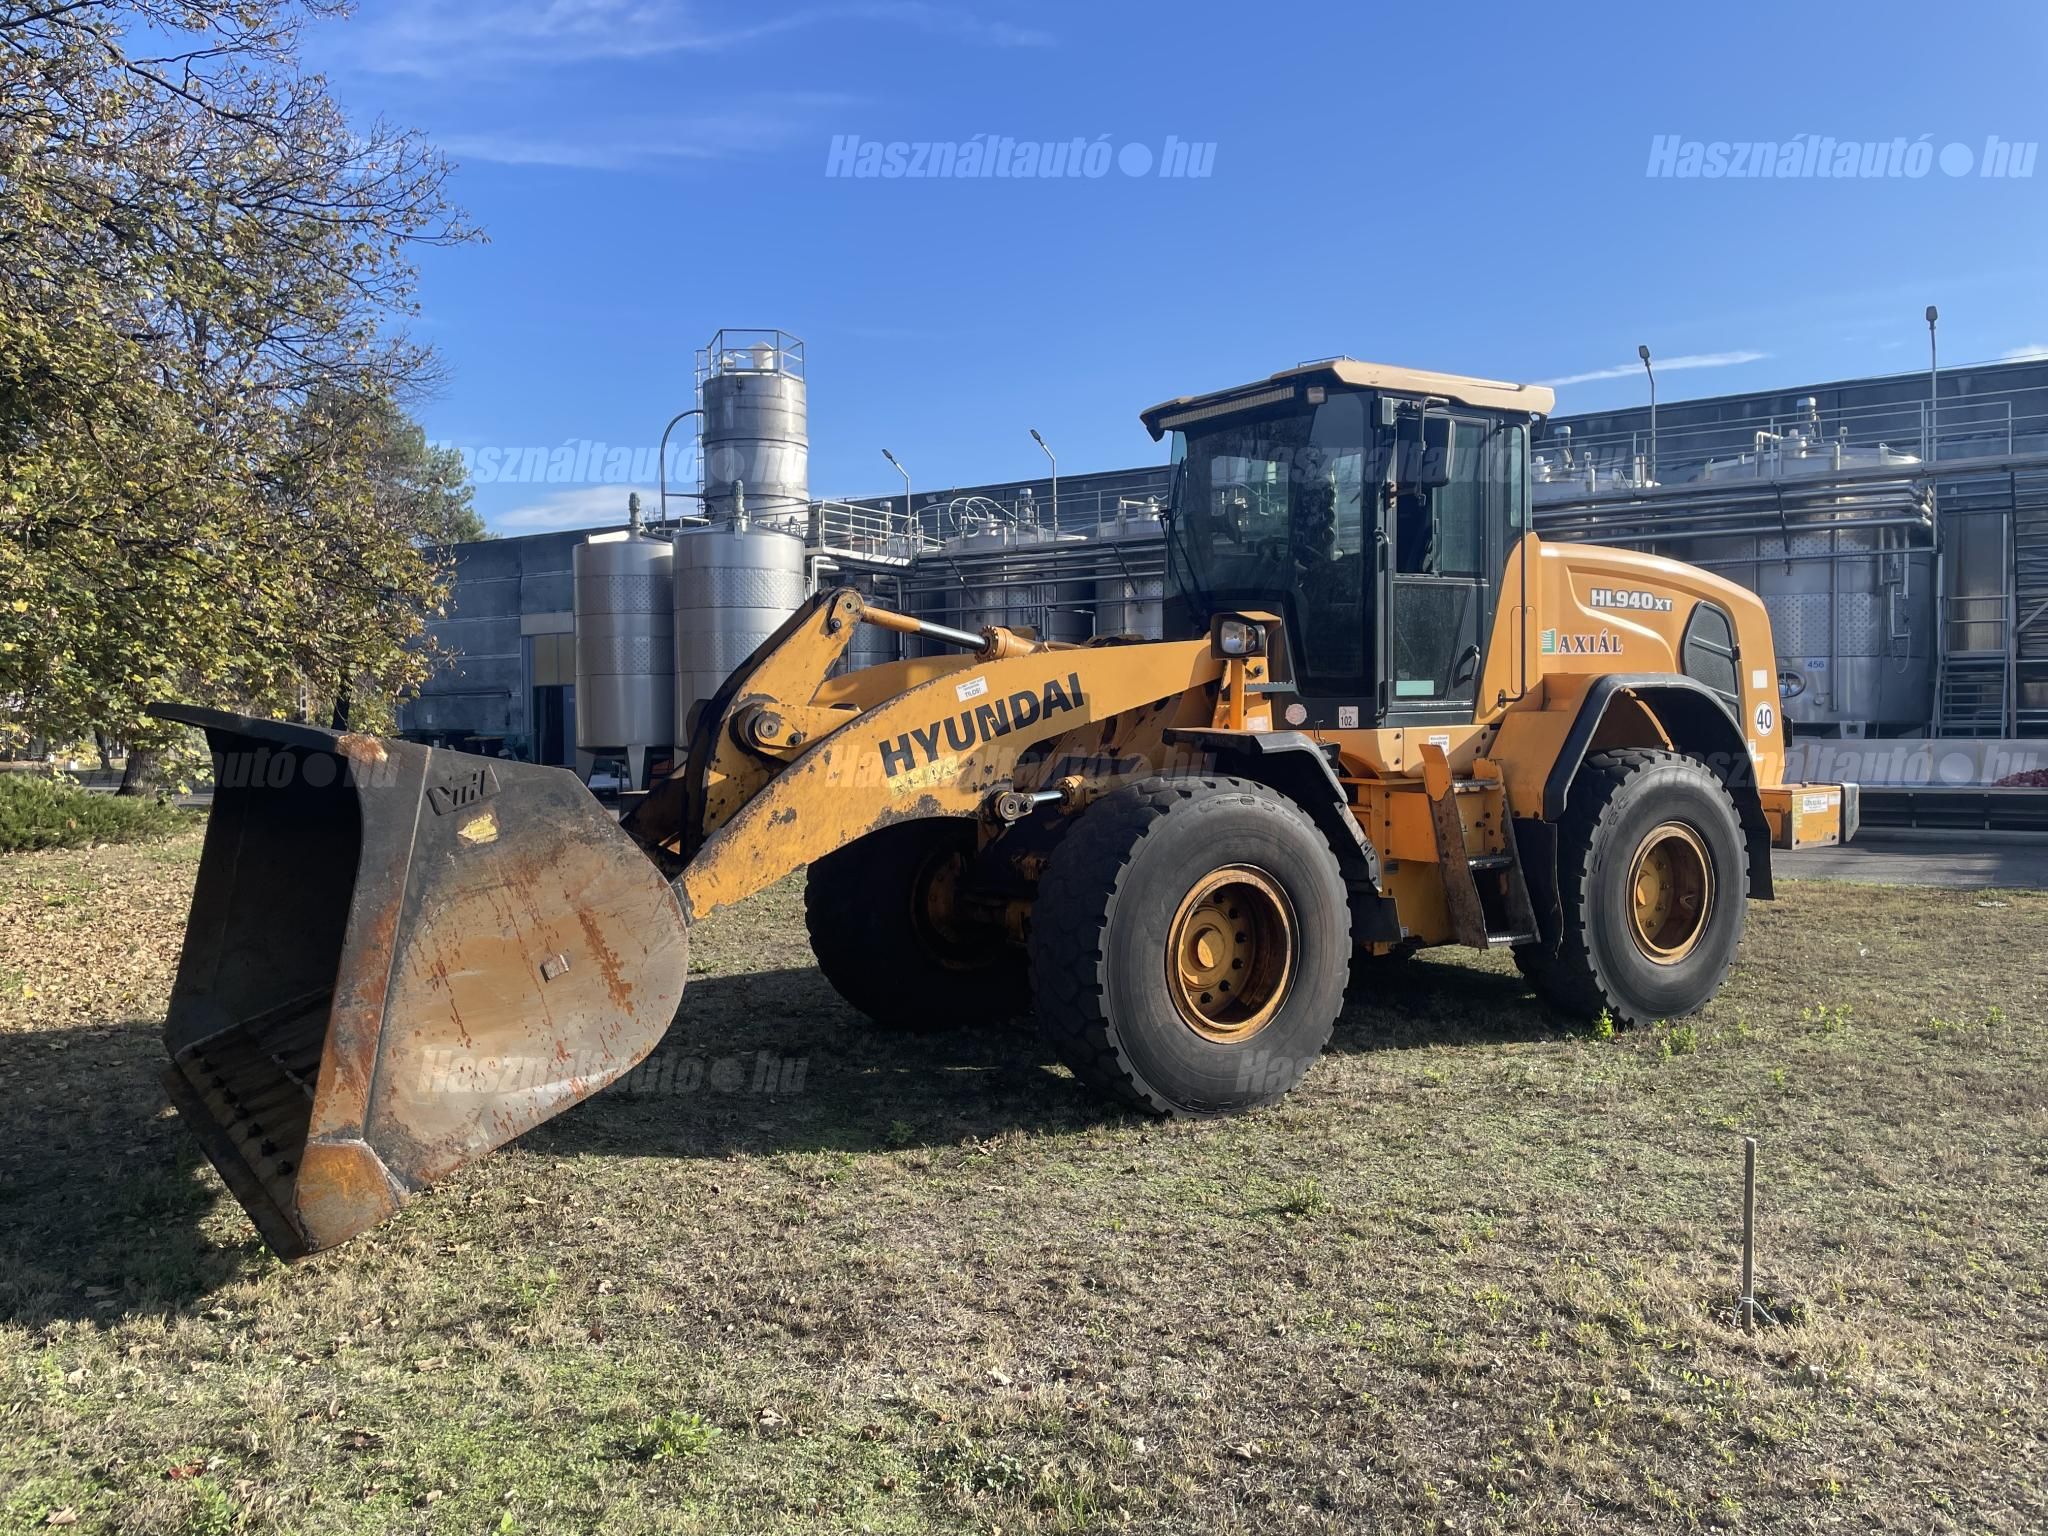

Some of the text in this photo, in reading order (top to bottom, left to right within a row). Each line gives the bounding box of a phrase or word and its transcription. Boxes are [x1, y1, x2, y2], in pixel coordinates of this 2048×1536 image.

[1557, 628, 1623, 655] AXIÁL
[1807, 660, 1825, 669] 456
[879, 672, 1084, 778] HYUNDAI
[1340, 715, 1353, 727] 102
[1756, 708, 1772, 730] 40
